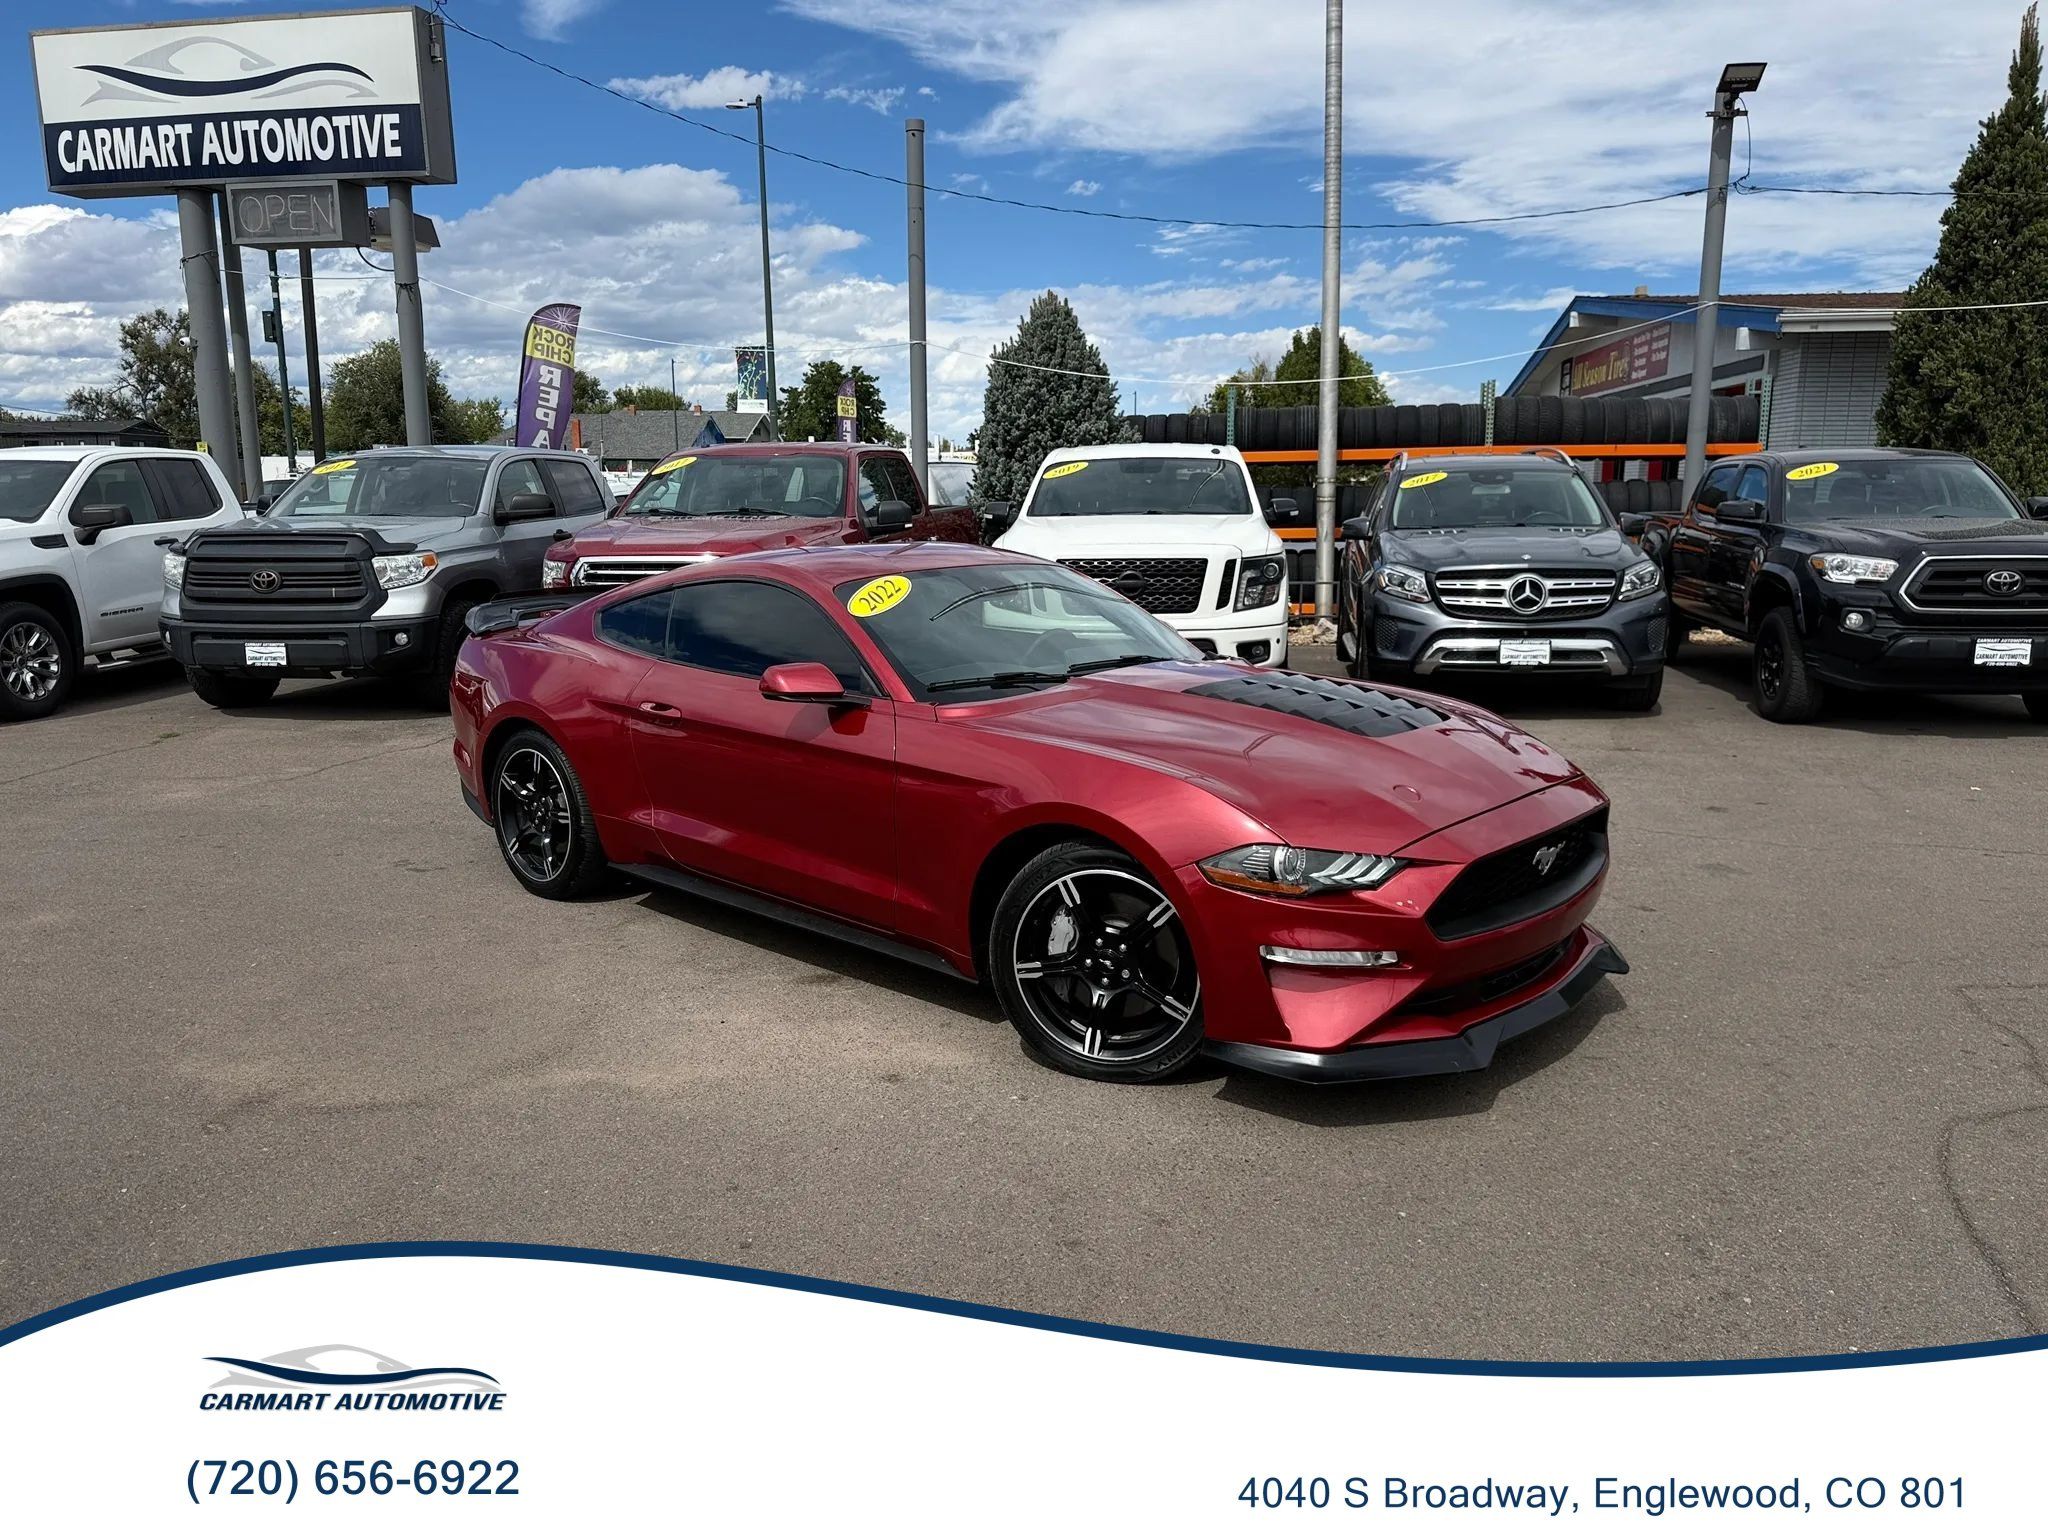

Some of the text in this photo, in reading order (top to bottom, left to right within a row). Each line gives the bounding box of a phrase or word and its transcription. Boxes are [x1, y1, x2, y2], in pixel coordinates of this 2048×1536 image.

[57, 113, 402, 173] CARMART AUTOMOTIVE
[238, 194, 334, 233] OPEN
[1409, 474, 1439, 487] 2017
[1798, 464, 1827, 478] 2021
[859, 580, 902, 612] 2022
[100, 606, 144, 617] SIERRA
